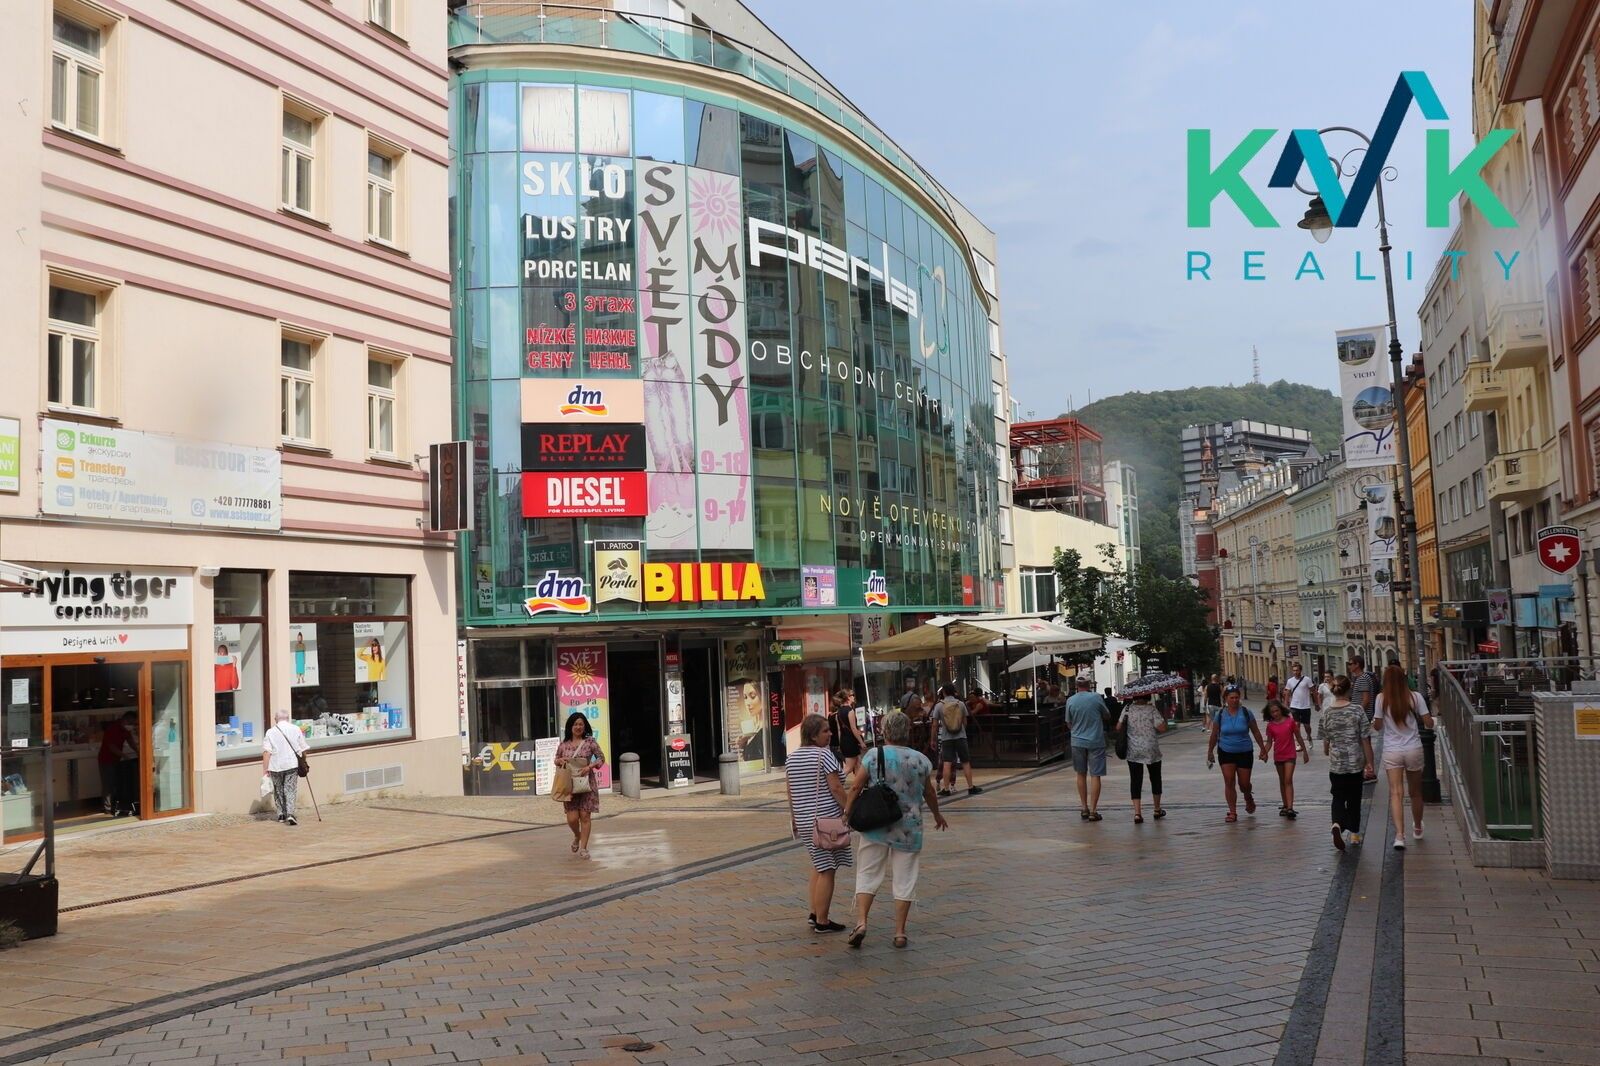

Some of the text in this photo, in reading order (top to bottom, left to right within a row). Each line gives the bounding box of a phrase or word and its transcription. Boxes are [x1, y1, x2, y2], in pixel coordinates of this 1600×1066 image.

[523, 160, 626, 199] SKLO
[525, 215, 632, 242] LUSTRY
[524, 260, 632, 281] PORCELAN
[638, 166, 683, 358] SVĚT
[564, 292, 577, 311] 3
[527, 323, 576, 345] NÍZKÉ
[528, 351, 574, 369] CENY
[751, 341, 884, 393] OBCHODNÍ
[568, 385, 602, 404] dm
[538, 433, 630, 453] REPLAY
[213, 495, 233, 507] +420
[547, 477, 626, 507] DIESEL
[820, 494, 882, 520] NOVĚ
[890, 503, 962, 533] OTEVŘENO
[860, 529, 891, 544] OPEN
[110, 570, 177, 602] tiger
[538, 573, 582, 598] dm
[600, 574, 637, 589] Perla
[644, 563, 766, 601] BILLA
[869, 572, 885, 592] dm
[56, 603, 149, 620] copenhagen
[63, 636, 118, 649] Designed with
[560, 648, 602, 666] SVĚT
[771, 692, 780, 727] REPLAY
